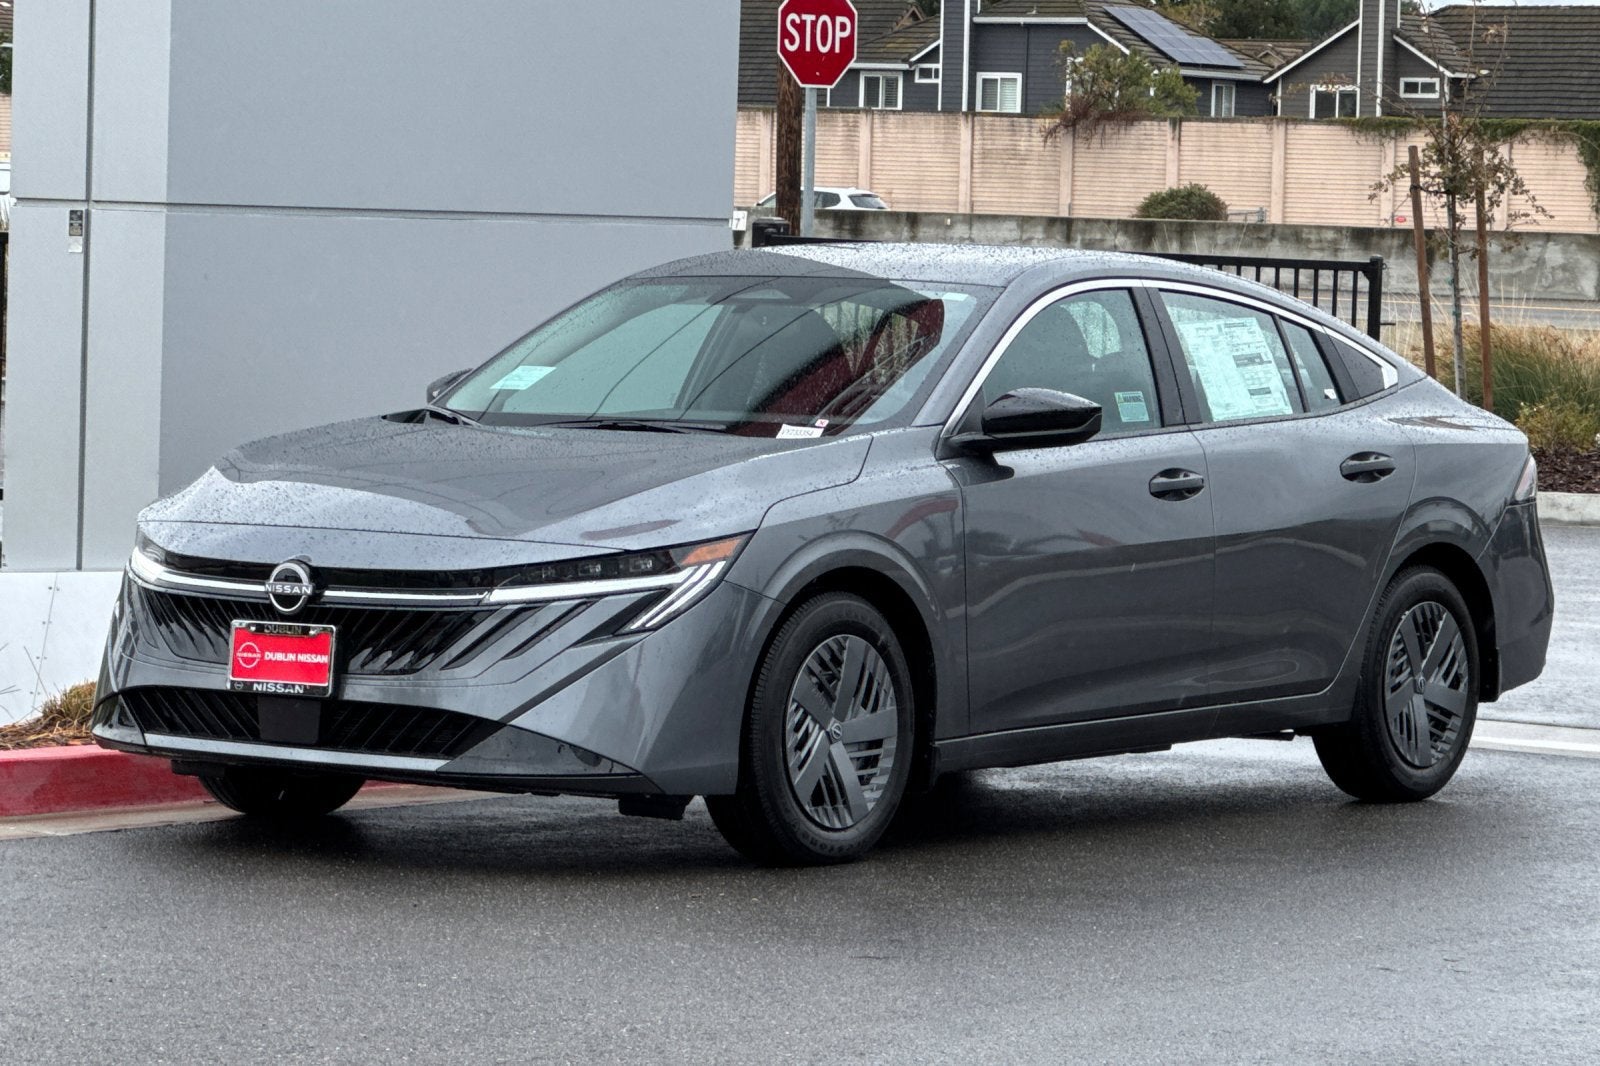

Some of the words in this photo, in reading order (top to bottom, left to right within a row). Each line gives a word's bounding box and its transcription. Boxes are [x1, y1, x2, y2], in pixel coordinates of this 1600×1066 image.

[784, 13, 851, 53] STOP
[265, 584, 311, 594] NISSAN
[264, 624, 302, 634] DUBLIN
[265, 651, 295, 662] DUBLIN
[297, 653, 328, 664] NISSAN
[254, 682, 303, 694] NISSAN
